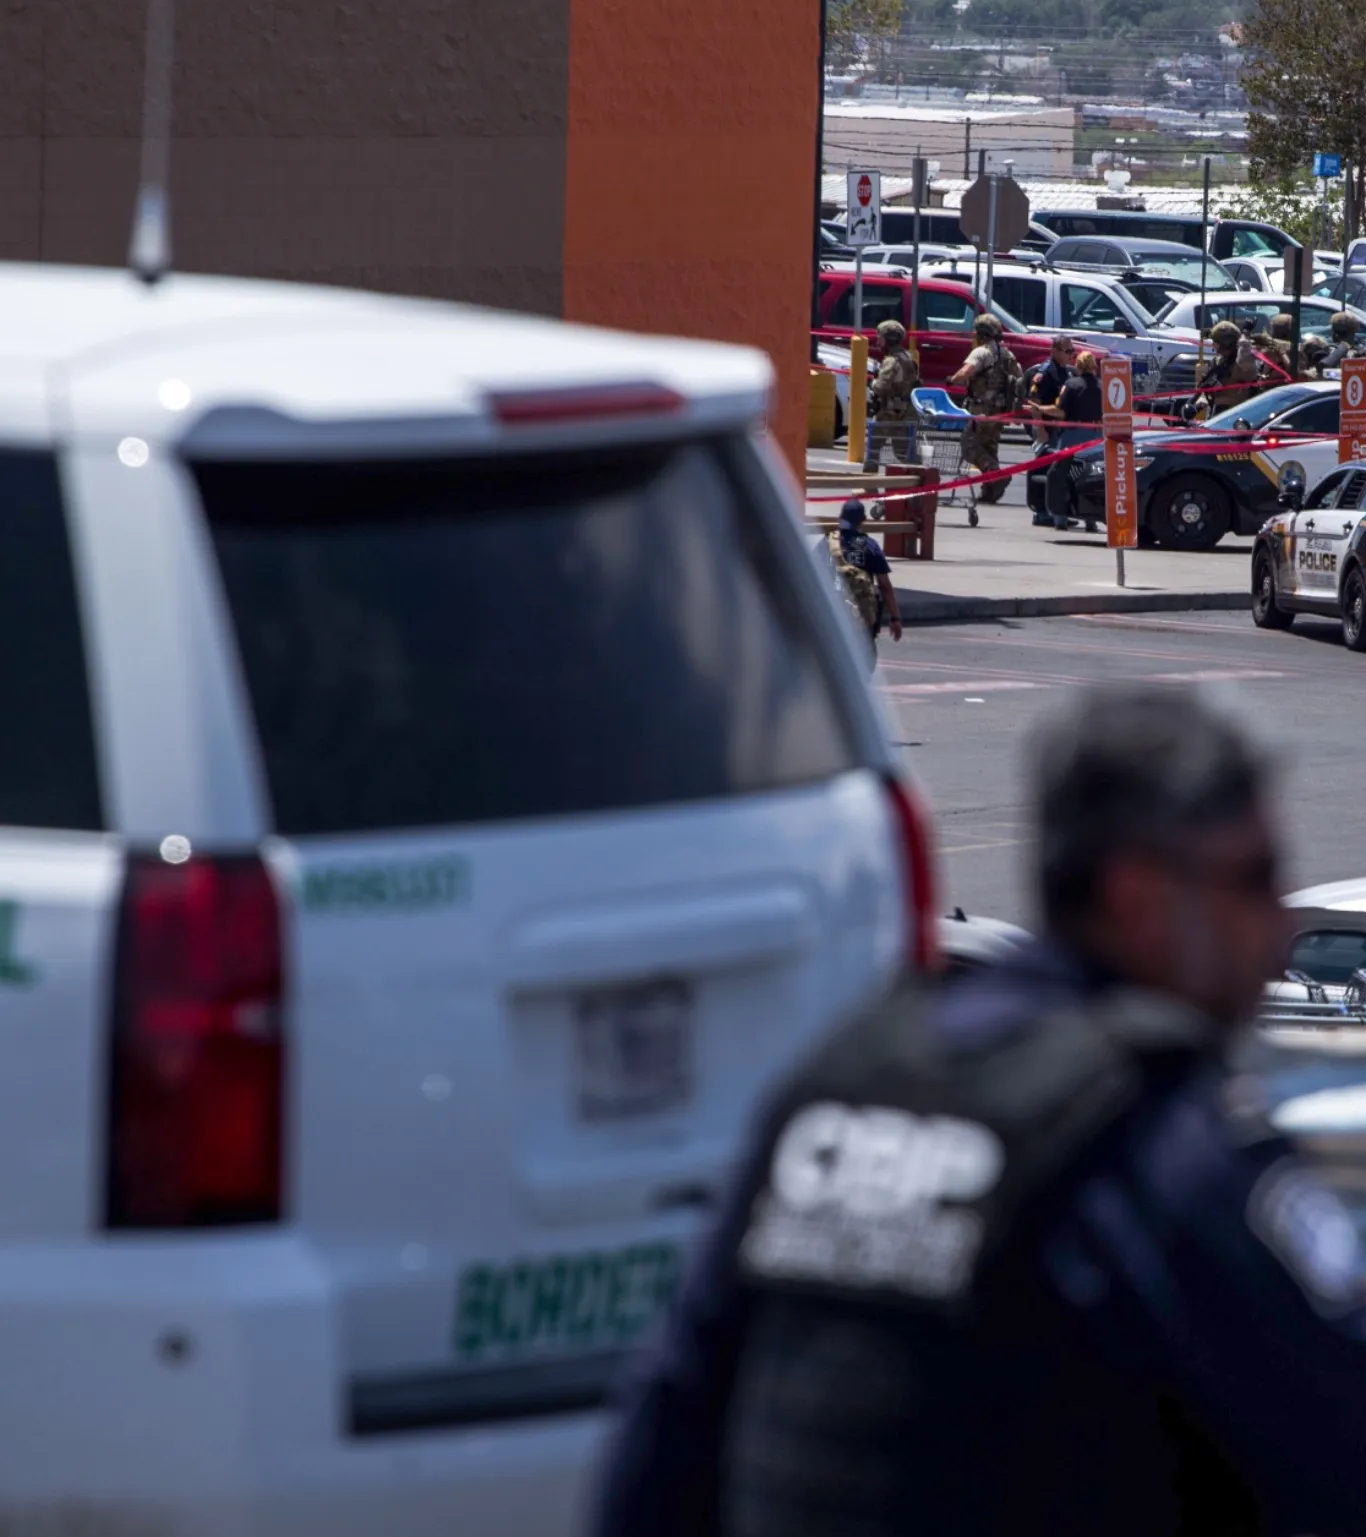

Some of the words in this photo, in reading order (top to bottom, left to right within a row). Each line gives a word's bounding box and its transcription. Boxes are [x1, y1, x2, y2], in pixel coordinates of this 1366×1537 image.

[857, 184, 872, 197] STOP
[1112, 382, 1120, 407] 7
[1351, 381, 1358, 401] 8
[1115, 442, 1128, 515] Pickup
[1300, 551, 1337, 571] POLICE
[772, 1100, 1006, 1215] CBP
